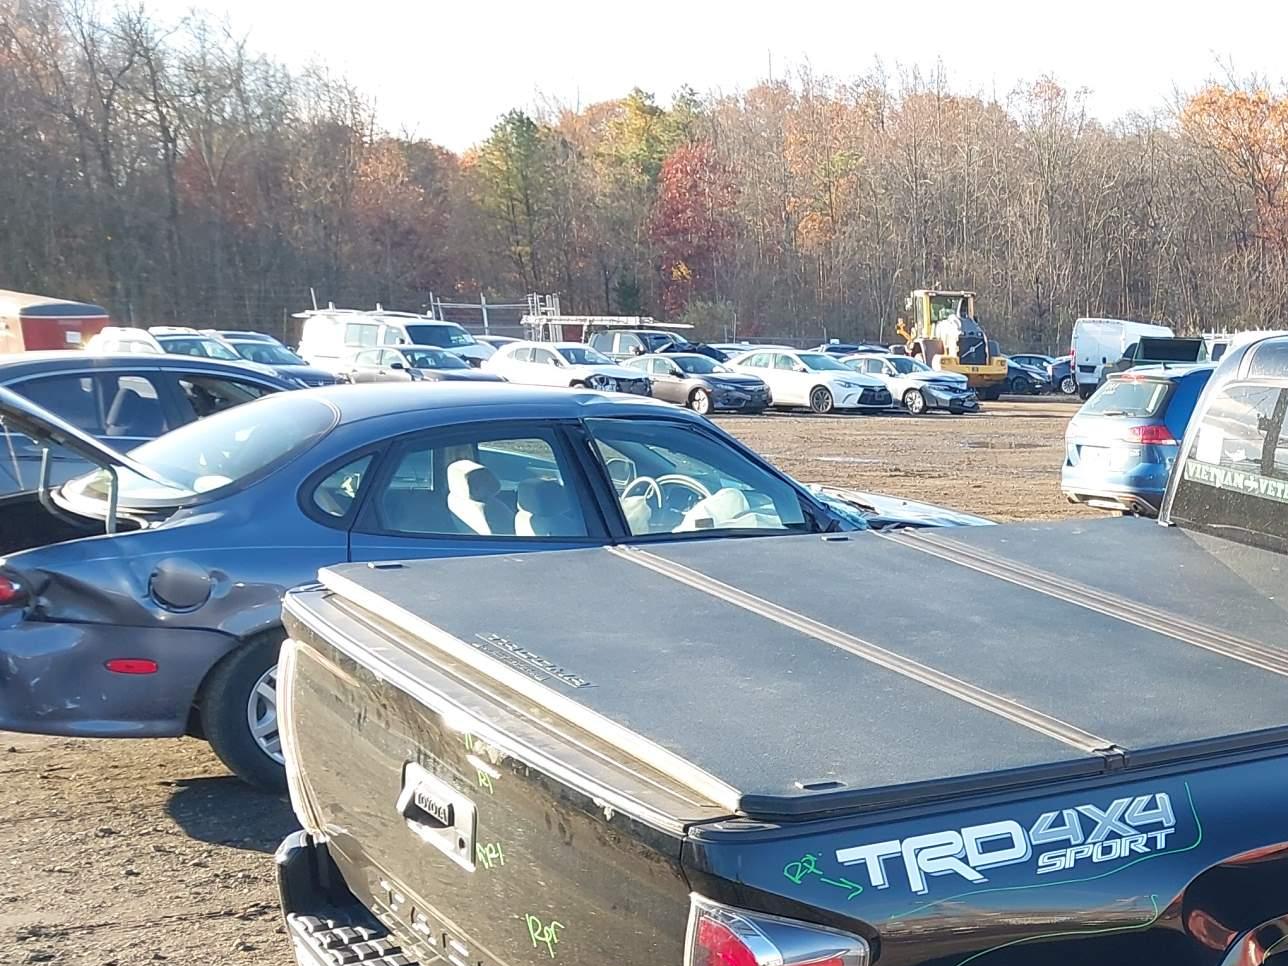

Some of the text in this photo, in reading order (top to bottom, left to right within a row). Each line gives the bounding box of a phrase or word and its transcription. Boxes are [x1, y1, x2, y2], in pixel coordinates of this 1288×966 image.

[1187, 461, 1245, 489] VIETNAM
[836, 820, 1032, 895] TRD
[1036, 828, 1176, 875] SPORT
